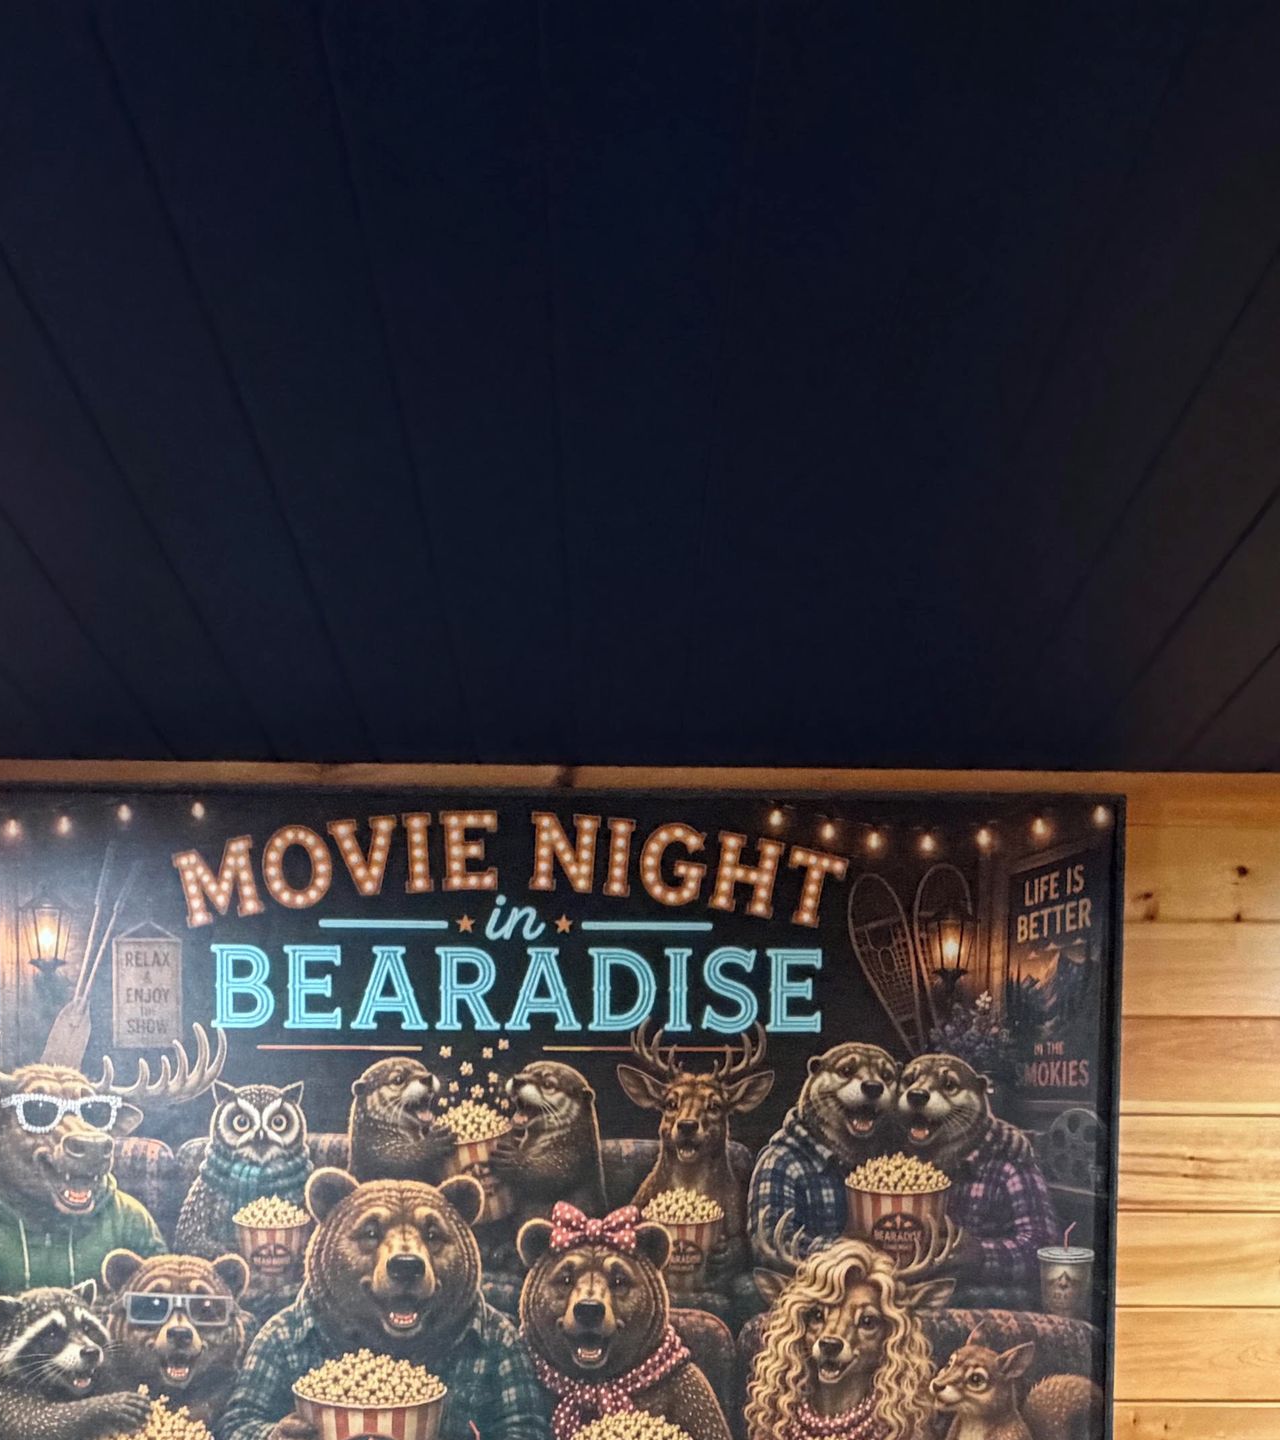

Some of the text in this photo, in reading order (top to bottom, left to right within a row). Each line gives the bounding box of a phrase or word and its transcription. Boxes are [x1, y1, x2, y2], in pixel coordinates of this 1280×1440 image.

[172, 810, 849, 928] MOVIE NIGHT
[1024, 864, 1085, 907] LIFE IS
[485, 894, 547, 942] in
[1017, 898, 1092, 943] BETTER
[125, 951, 170, 967] RELAX
[125, 988, 170, 1003] ENJOY
[210, 945, 824, 1034] BEARADISE
